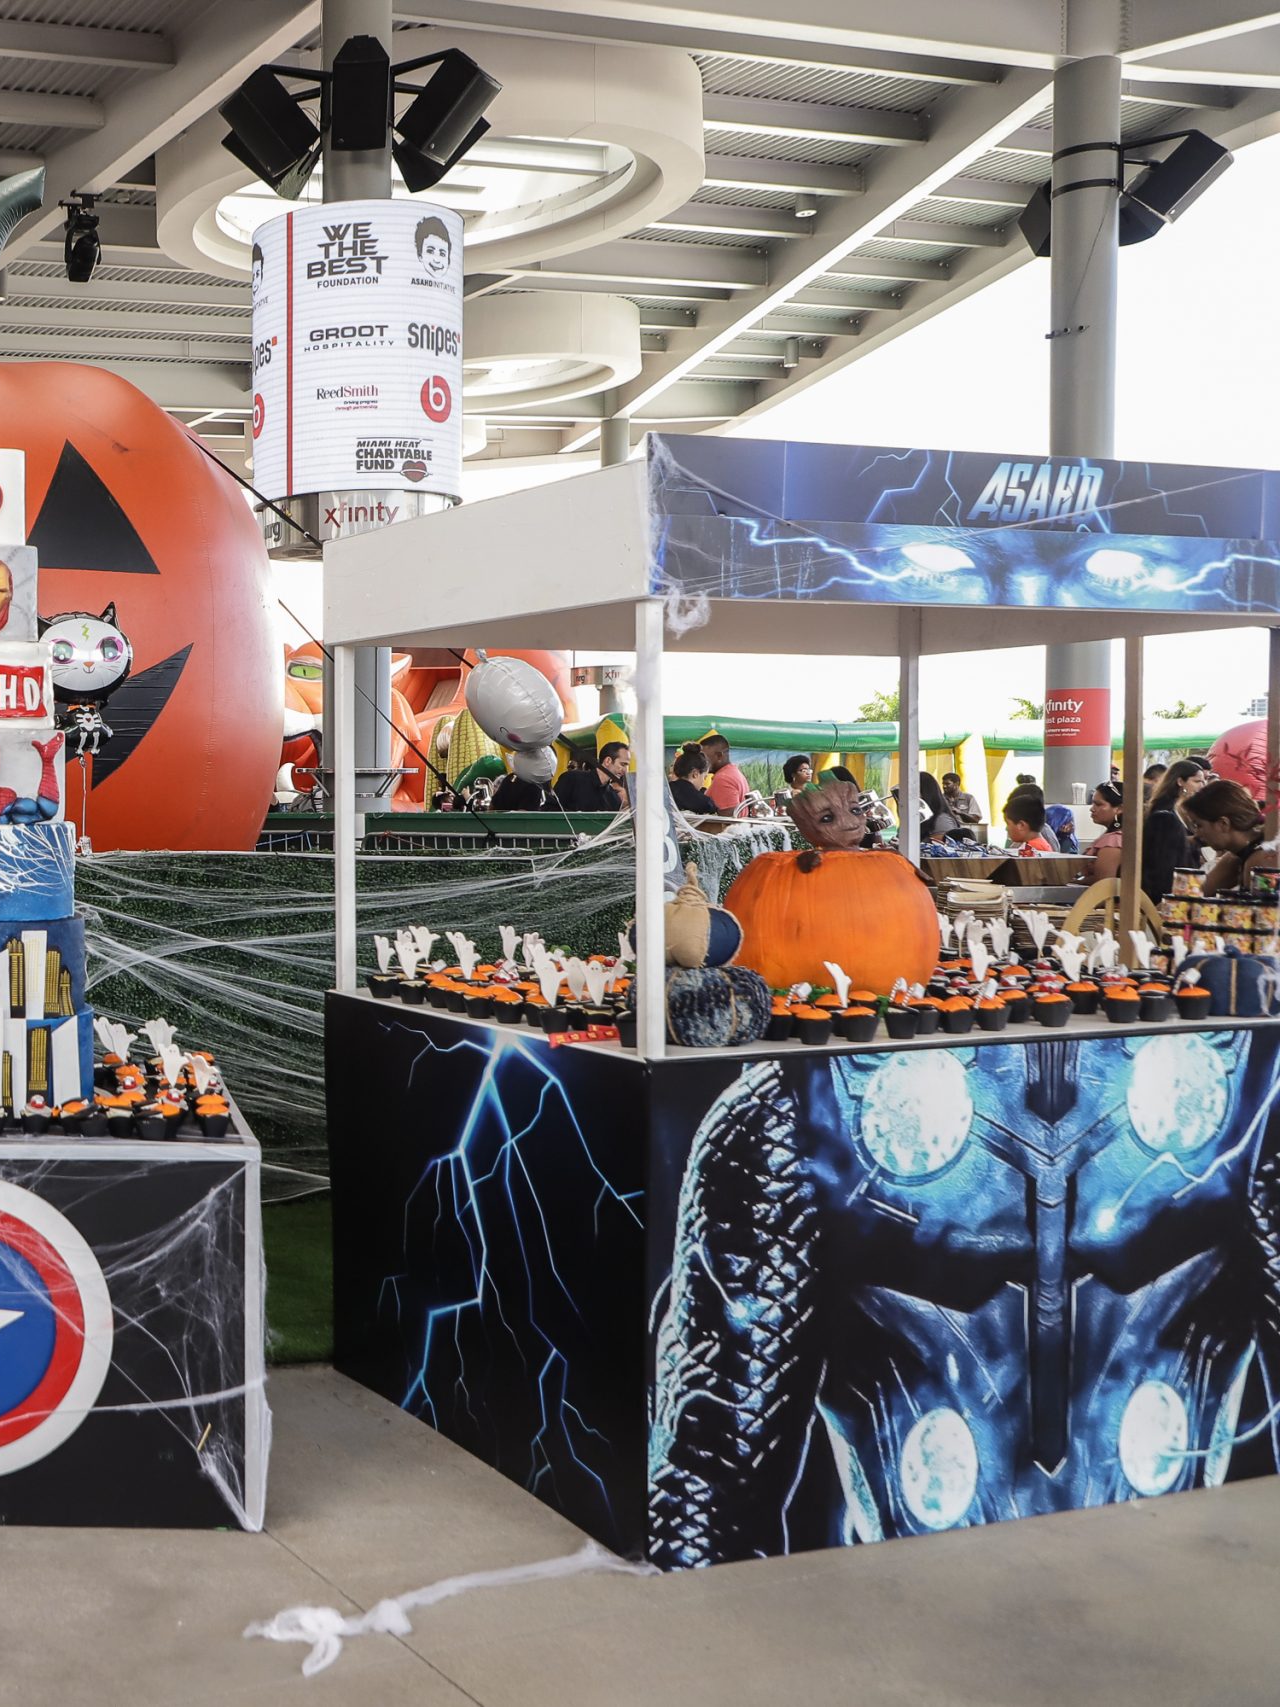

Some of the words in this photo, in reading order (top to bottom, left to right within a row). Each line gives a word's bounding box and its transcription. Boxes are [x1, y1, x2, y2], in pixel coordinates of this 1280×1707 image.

[322, 222, 372, 241] WE
[317, 238, 380, 259] THE
[307, 256, 389, 279] BEST
[317, 276, 379, 288] FOUNDATION
[309, 325, 389, 342] GROOT
[304, 340, 394, 352] HOSPITALITY
[317, 385, 379, 400] ReedSmith
[356, 440, 391, 448] MIAMI
[395, 440, 421, 448] HEAT
[355, 448, 432, 461] CHARITABLE
[356, 459, 395, 470] FUND
[967, 462, 1104, 524] ASAHD
[324, 501, 400, 528] xfinity
[1057, 715, 1081, 724] plaza
